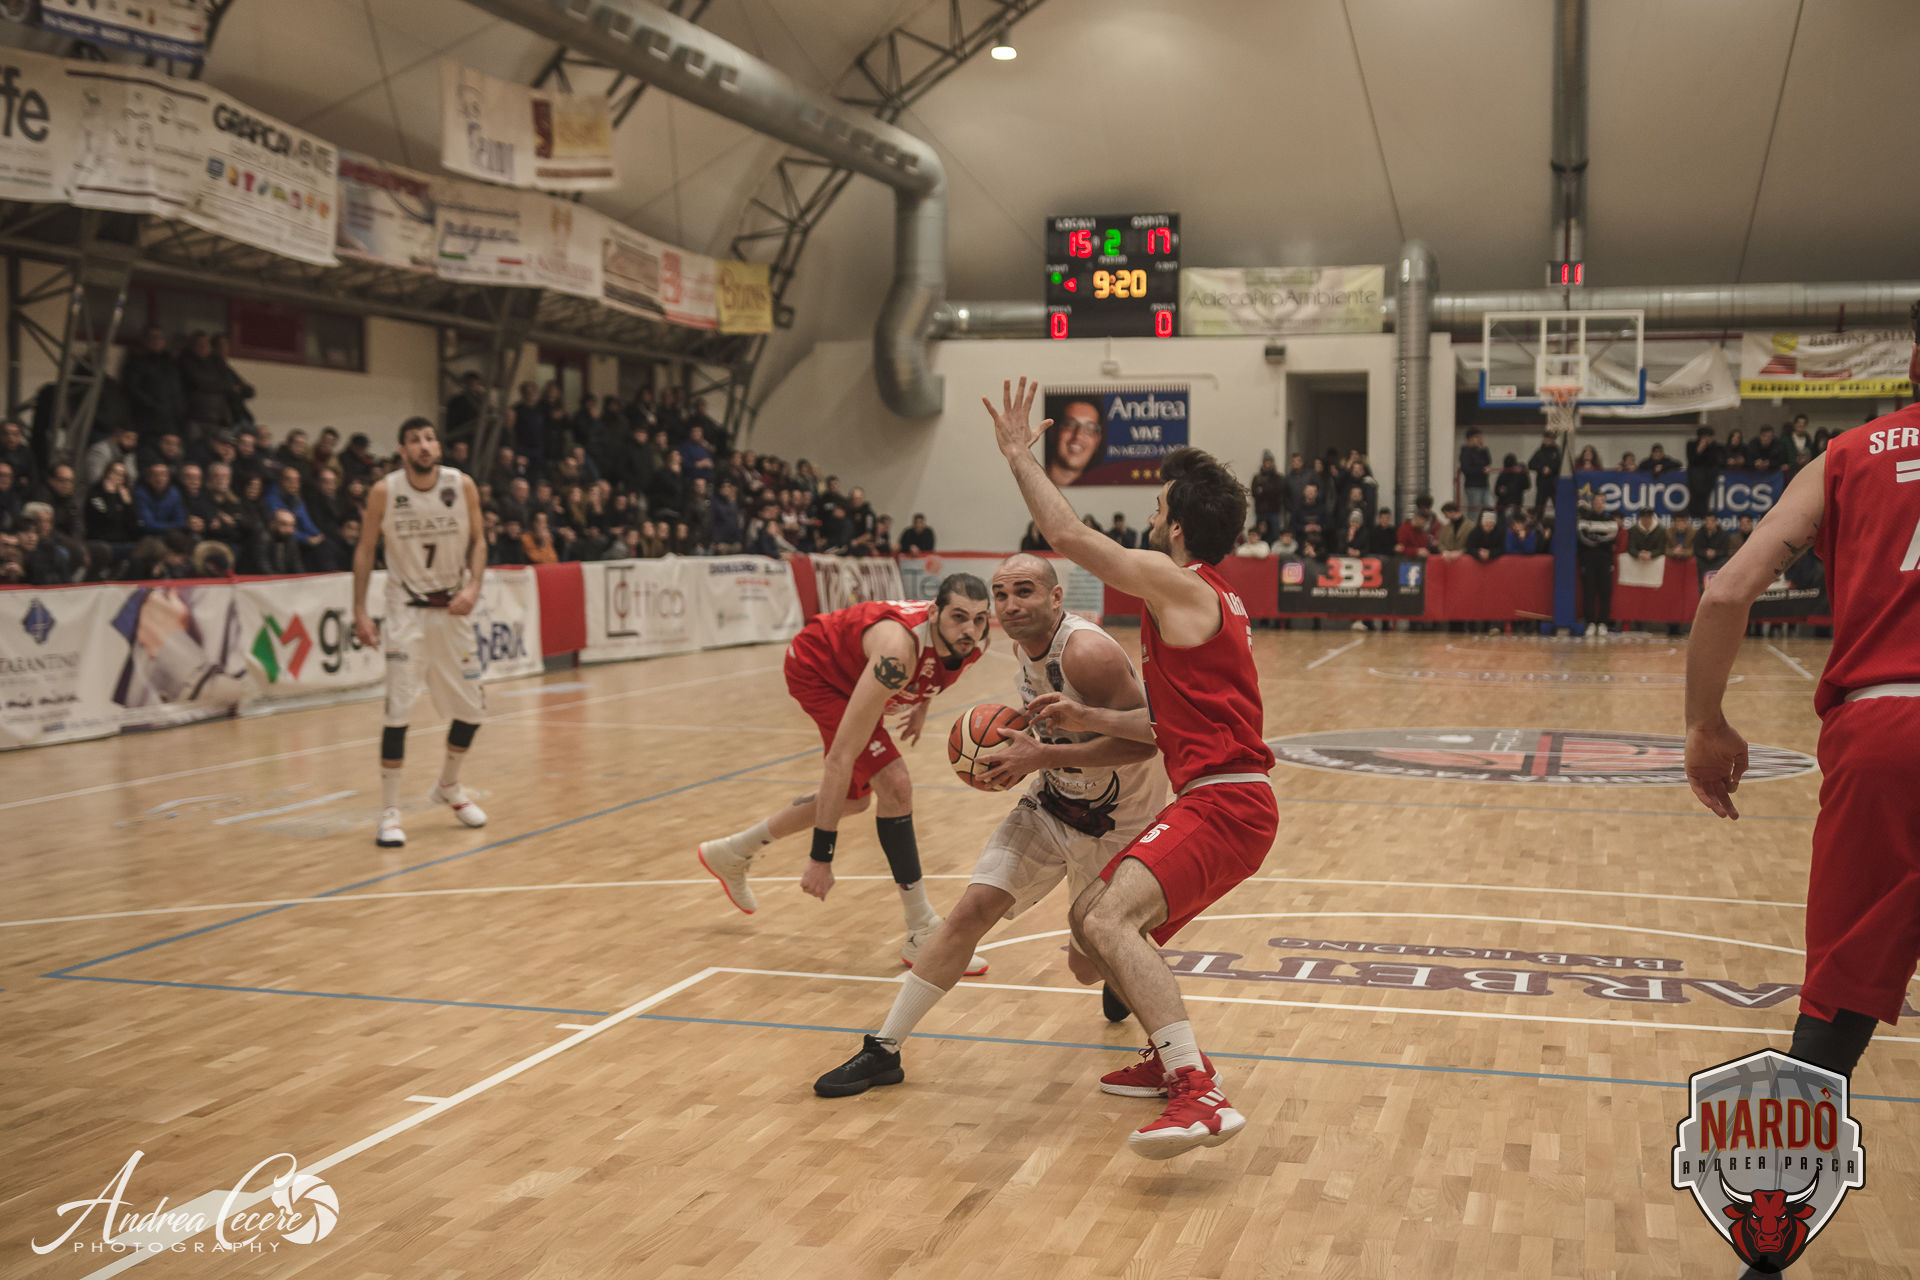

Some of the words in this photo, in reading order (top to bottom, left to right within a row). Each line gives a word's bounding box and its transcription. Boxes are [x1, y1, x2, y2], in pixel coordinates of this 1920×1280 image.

[1069, 230, 1092, 257] 15
[1104, 229, 1121, 256] 2
[1147, 227, 1171, 254] 17
[1092, 269, 1147, 299] 9:20
[1051, 312, 1068, 339] 0
[1155, 310, 1173, 337] 0
[1107, 394, 1186, 421] Andrea
[1130, 425, 1162, 442] VIVE
[422, 543, 437, 569] 7
[1139, 823, 1170, 844] 5
[1282, 939, 1512, 960] HOLDING
[1537, 952, 1665, 970] BRB
